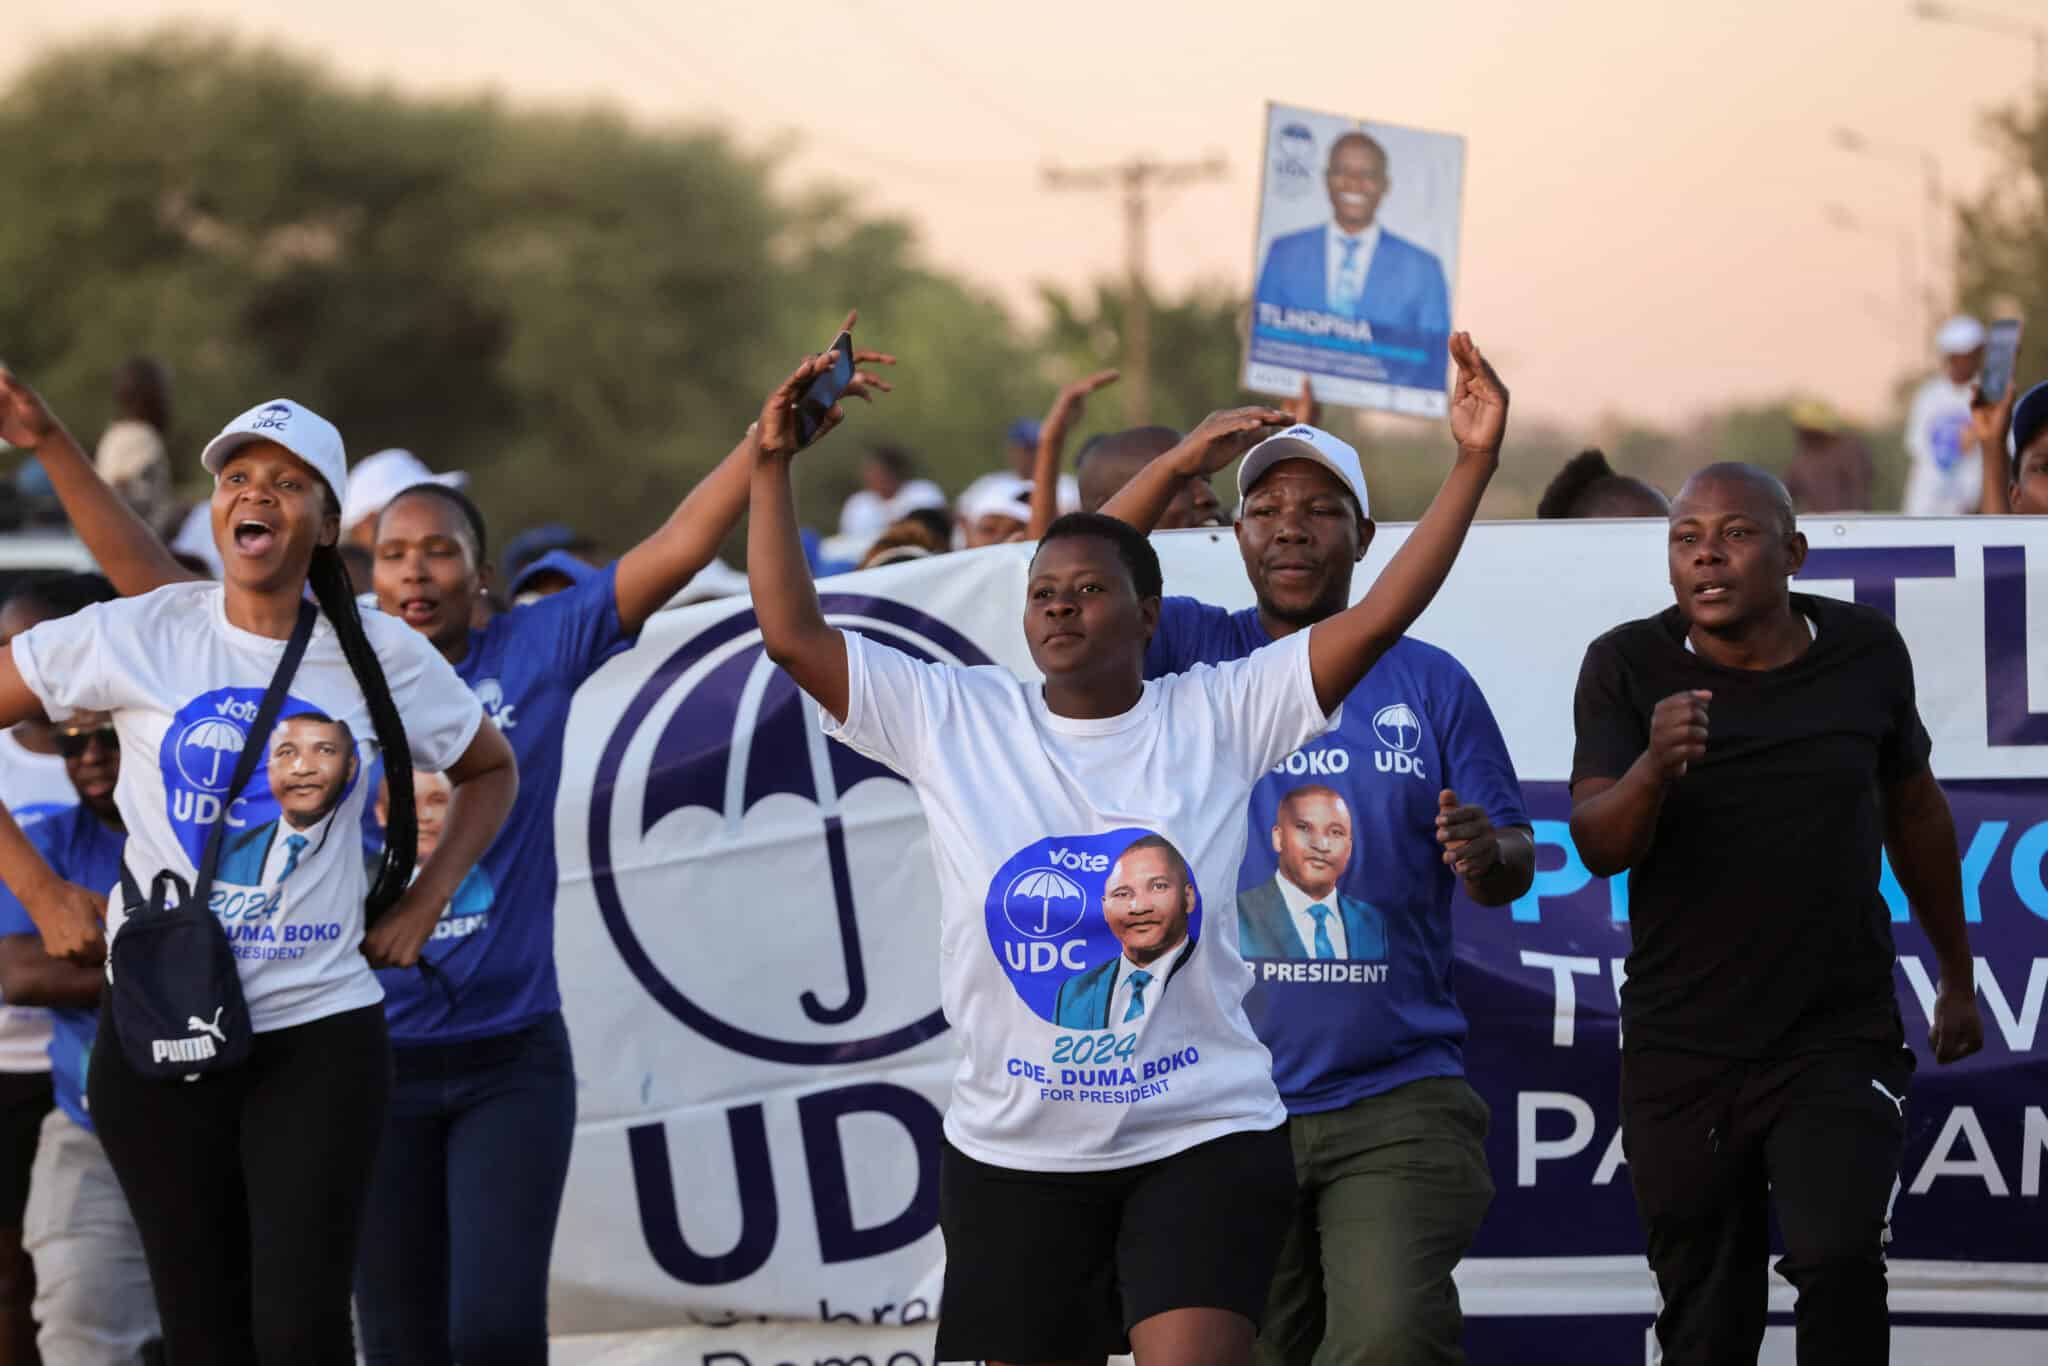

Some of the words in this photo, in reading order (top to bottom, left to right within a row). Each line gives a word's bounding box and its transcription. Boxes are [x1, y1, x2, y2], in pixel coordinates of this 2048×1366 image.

[252, 420, 287, 431] UDC
[215, 695, 259, 723] Vot
[1374, 750, 1426, 779] UDC
[173, 788, 247, 827] UDC
[208, 890, 282, 920] 2024
[225, 924, 275, 942] UMA
[283, 921, 341, 942] BOKO
[232, 945, 305, 960] RESIDENT
[1004, 939, 1087, 973] UDC
[1263, 963, 1389, 983] PRESIDENT
[151, 1034, 216, 1063] PUMA
[1052, 1033, 1137, 1065] 2024
[1007, 1058, 1052, 1084] CDE.
[1061, 1067, 1136, 1086] DUMA
[1143, 1046, 1199, 1080] BOKO
[1040, 1088, 1074, 1101] FOR
[1080, 1078, 1169, 1104] PRESIDENT
[627, 1082, 944, 1287] UD
